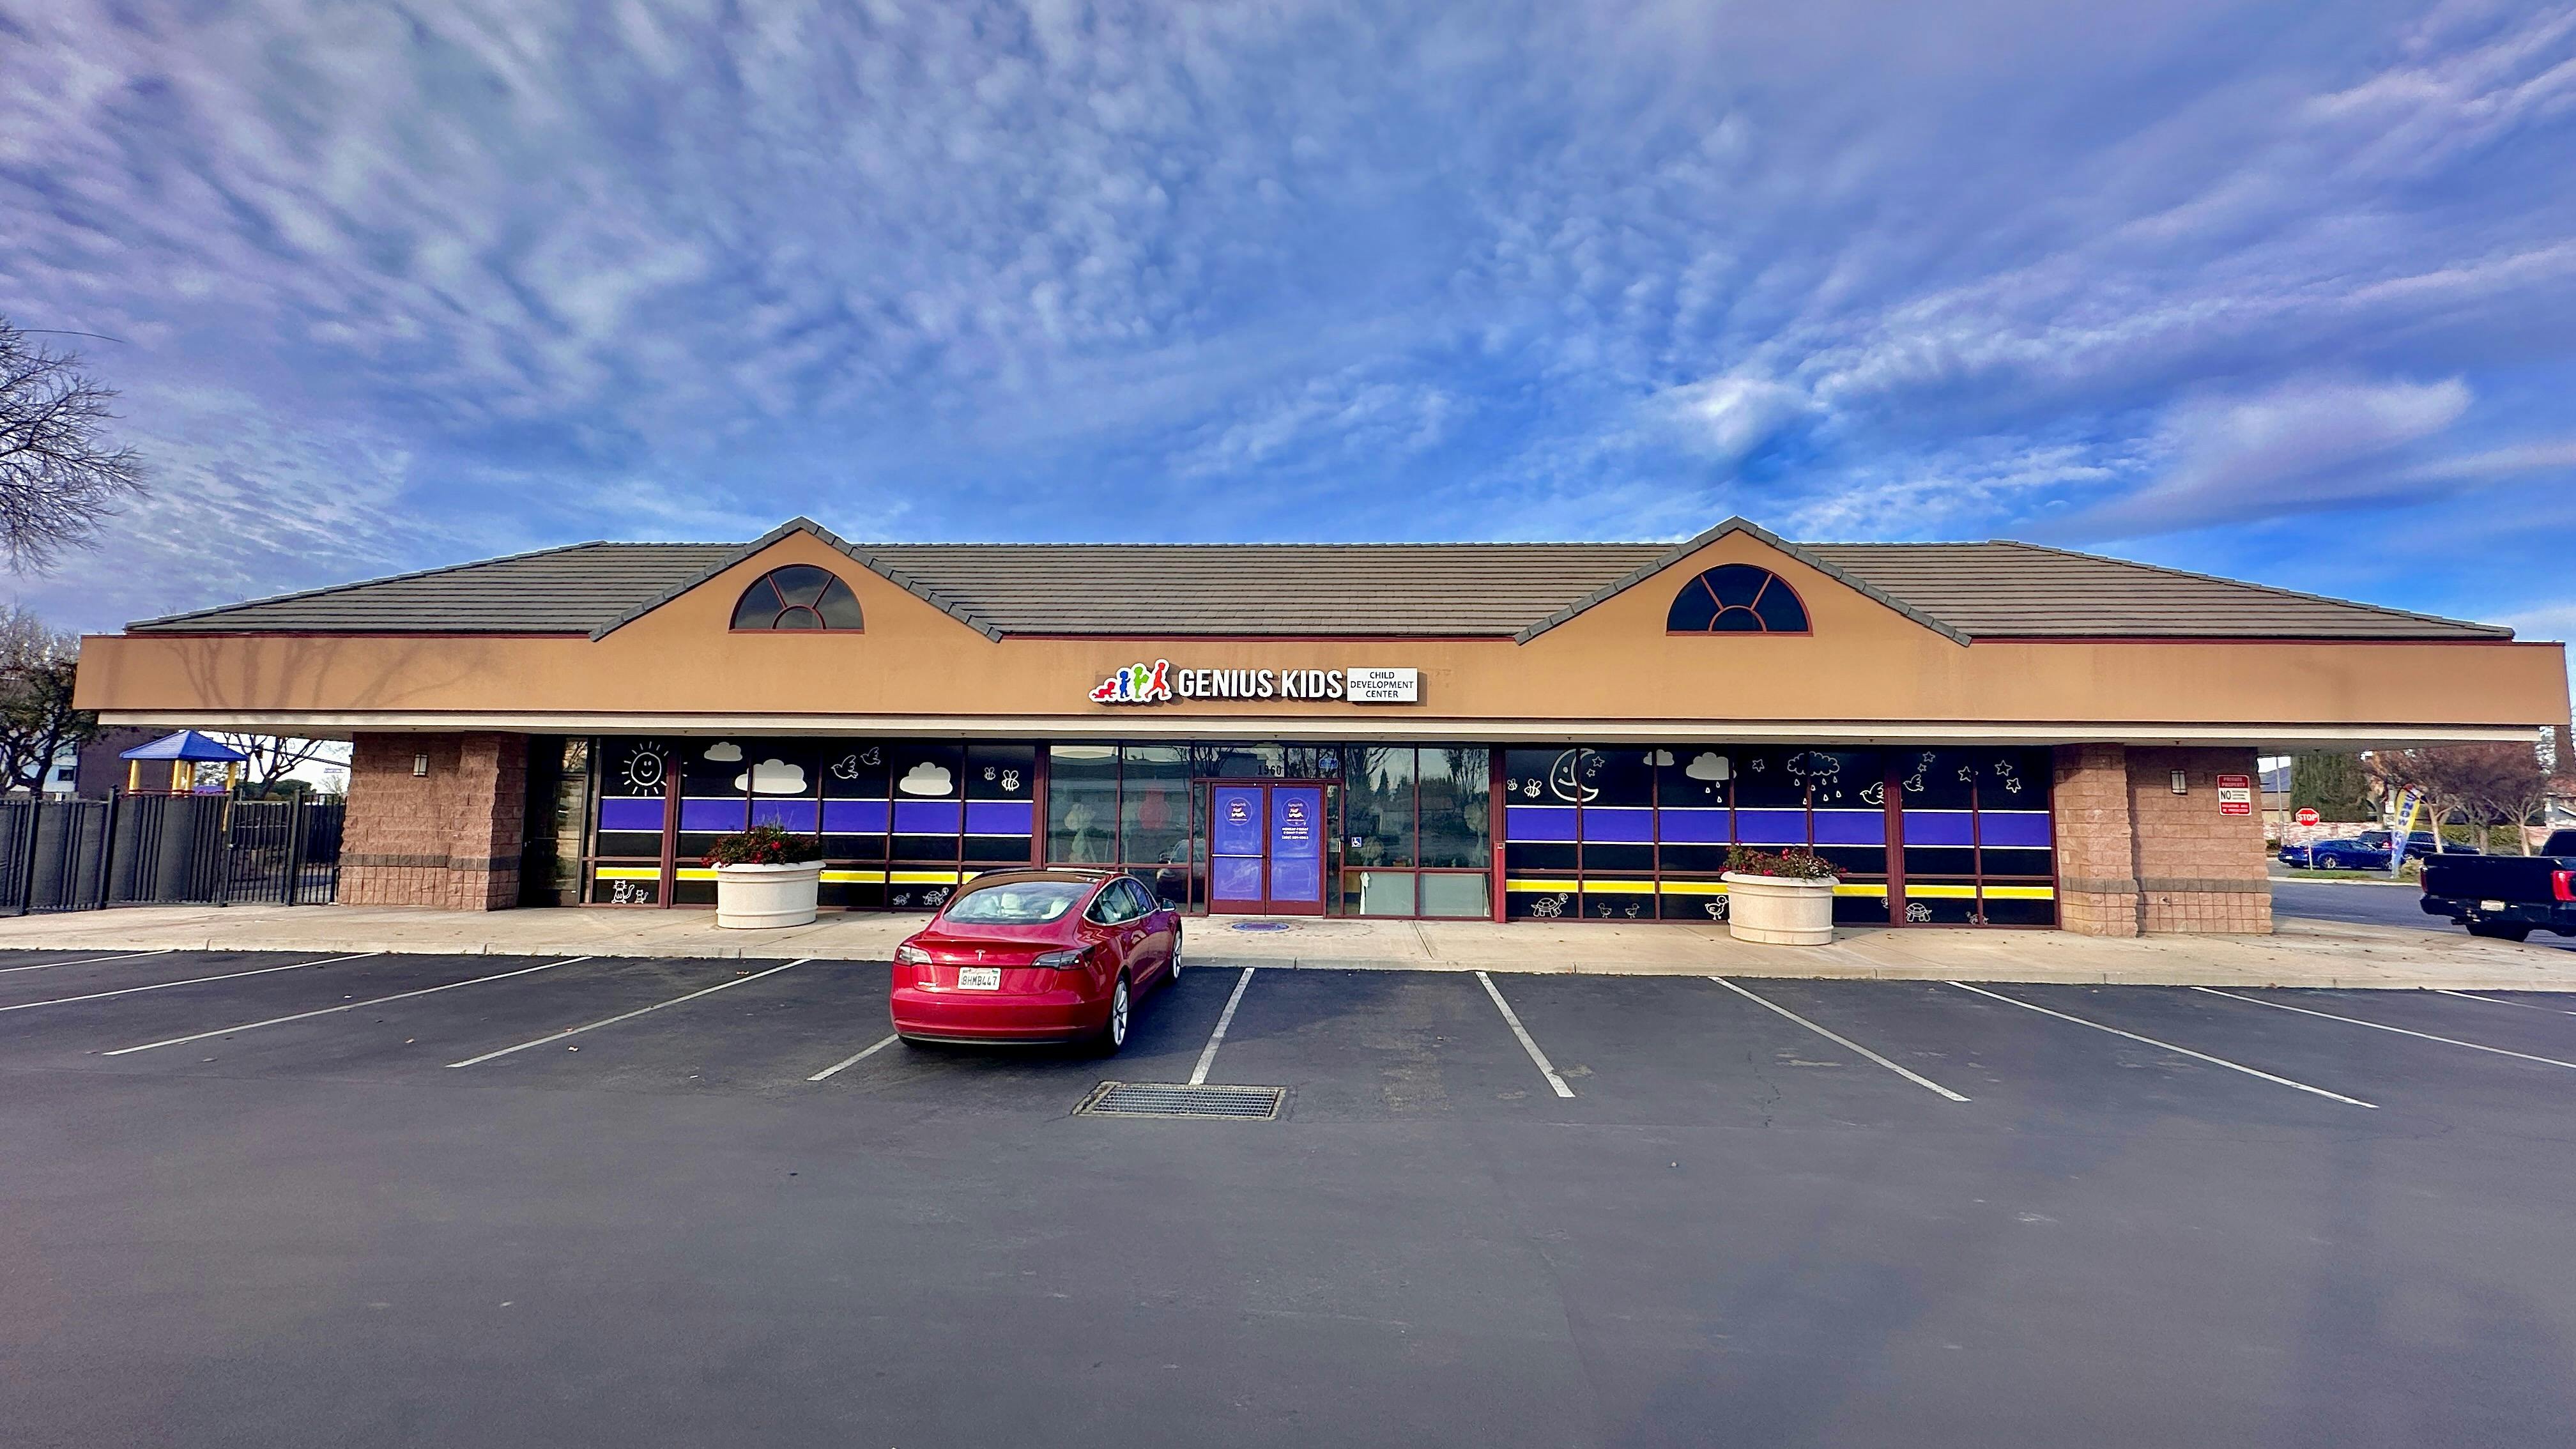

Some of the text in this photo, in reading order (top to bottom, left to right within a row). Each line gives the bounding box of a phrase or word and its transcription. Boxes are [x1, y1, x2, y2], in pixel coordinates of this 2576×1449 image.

[1178, 669, 1343, 698] GENIUS KIDS
[1350, 680, 1414, 689] DEVELOPMENT
[1365, 690, 1399, 698] CENTER
[1257, 765, 1282, 776] 1960
[2220, 790, 2232, 800] NO
